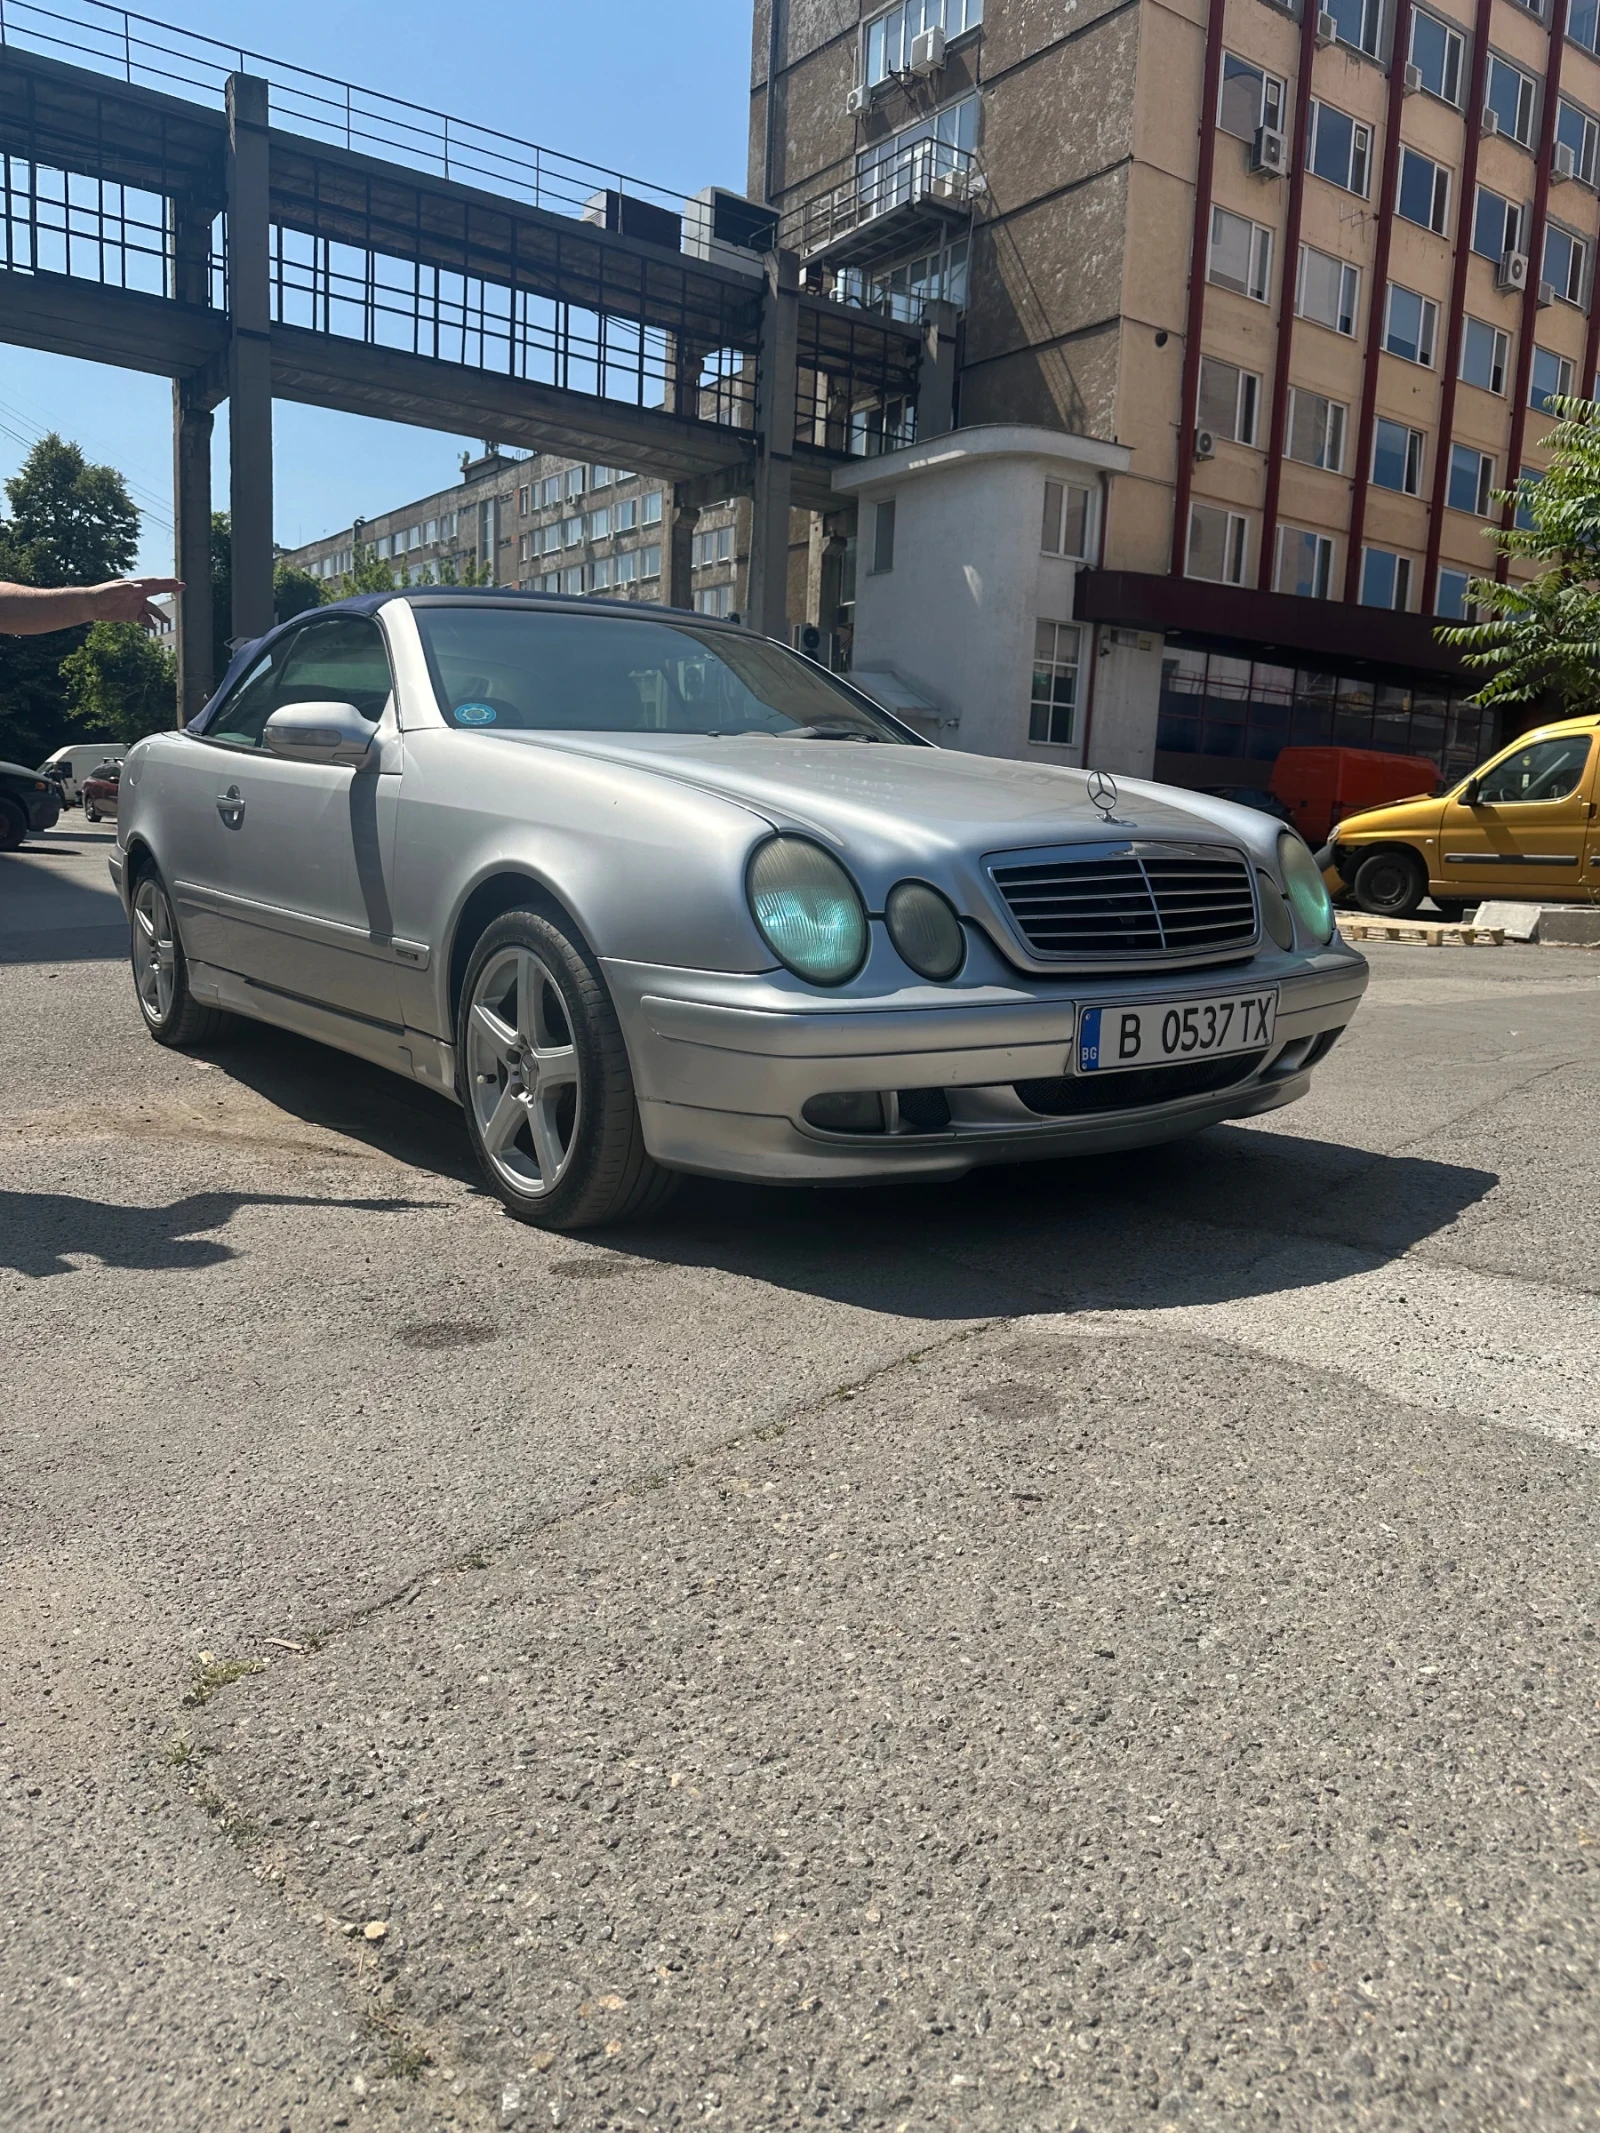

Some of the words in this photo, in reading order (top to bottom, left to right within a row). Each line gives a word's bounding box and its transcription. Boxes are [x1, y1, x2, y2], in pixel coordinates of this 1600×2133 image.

[1118, 1013, 1142, 1060] B
[1161, 1002, 1235, 1054] 0537
[1240, 997, 1272, 1043] TX
[1081, 1046, 1098, 1061] BG
